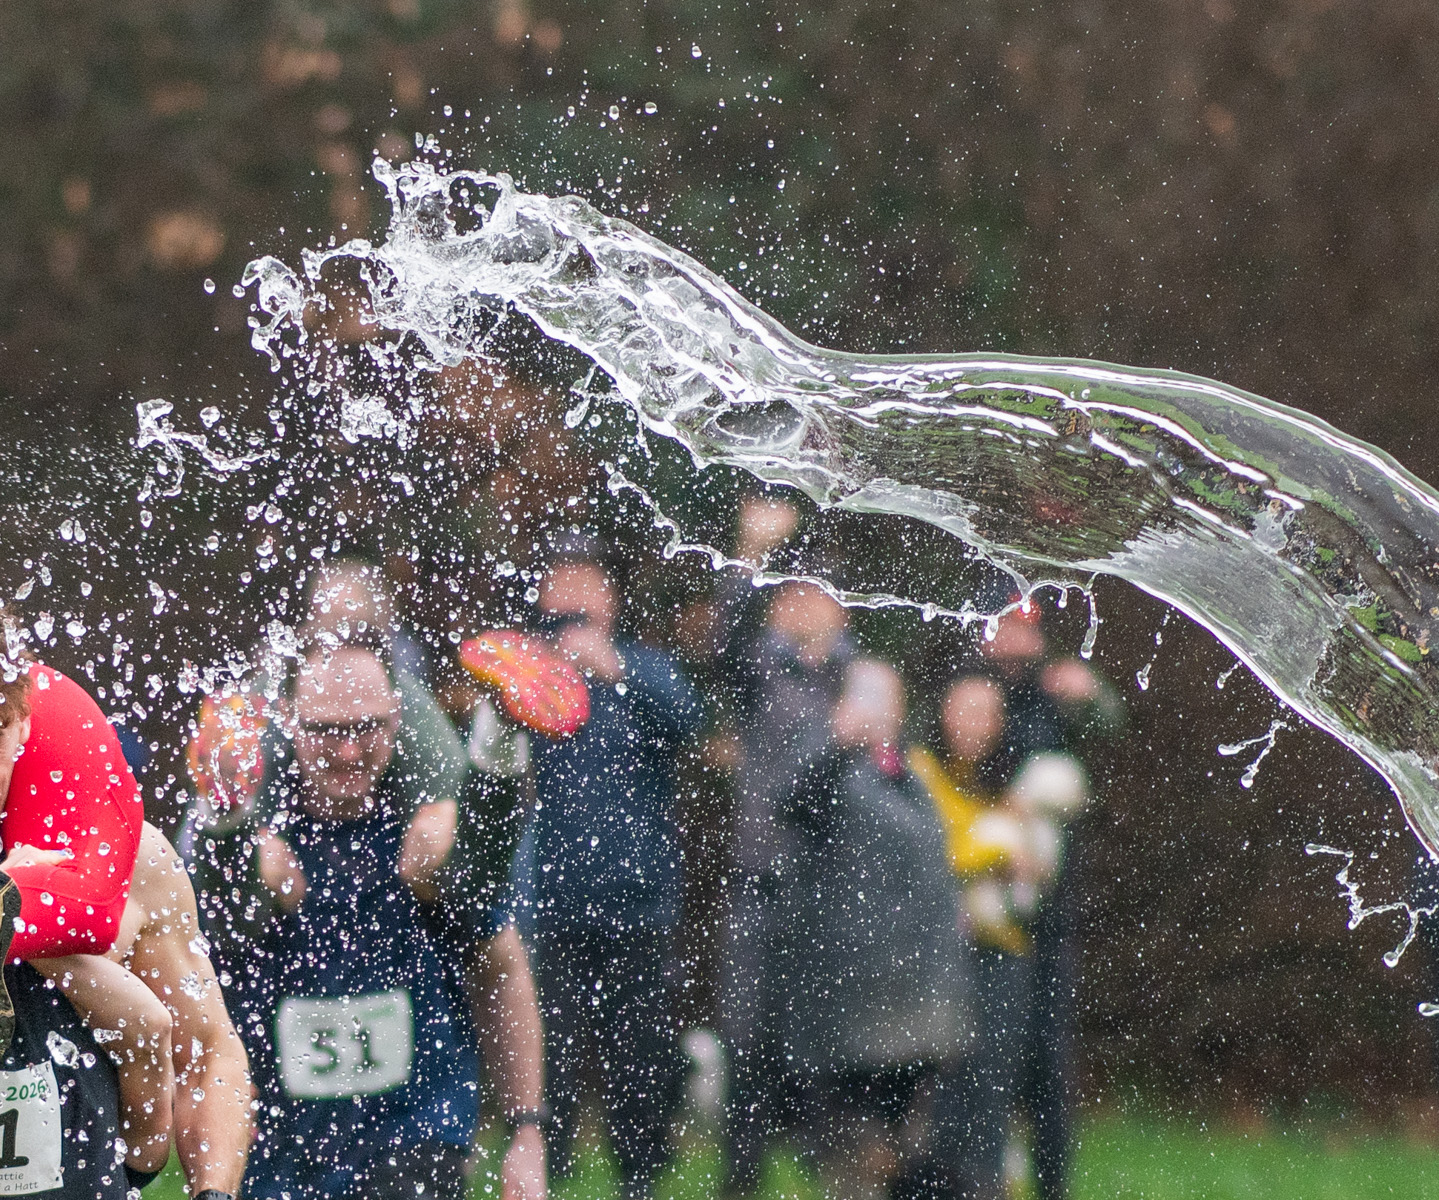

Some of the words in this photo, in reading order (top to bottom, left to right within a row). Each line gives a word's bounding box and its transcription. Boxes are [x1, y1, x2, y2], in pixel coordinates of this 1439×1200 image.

[311, 1026, 383, 1074] 51
[6, 1079, 46, 1101] 2026
[4, 1184, 11, 1192] a
[15, 1181, 39, 1191] Hatt
